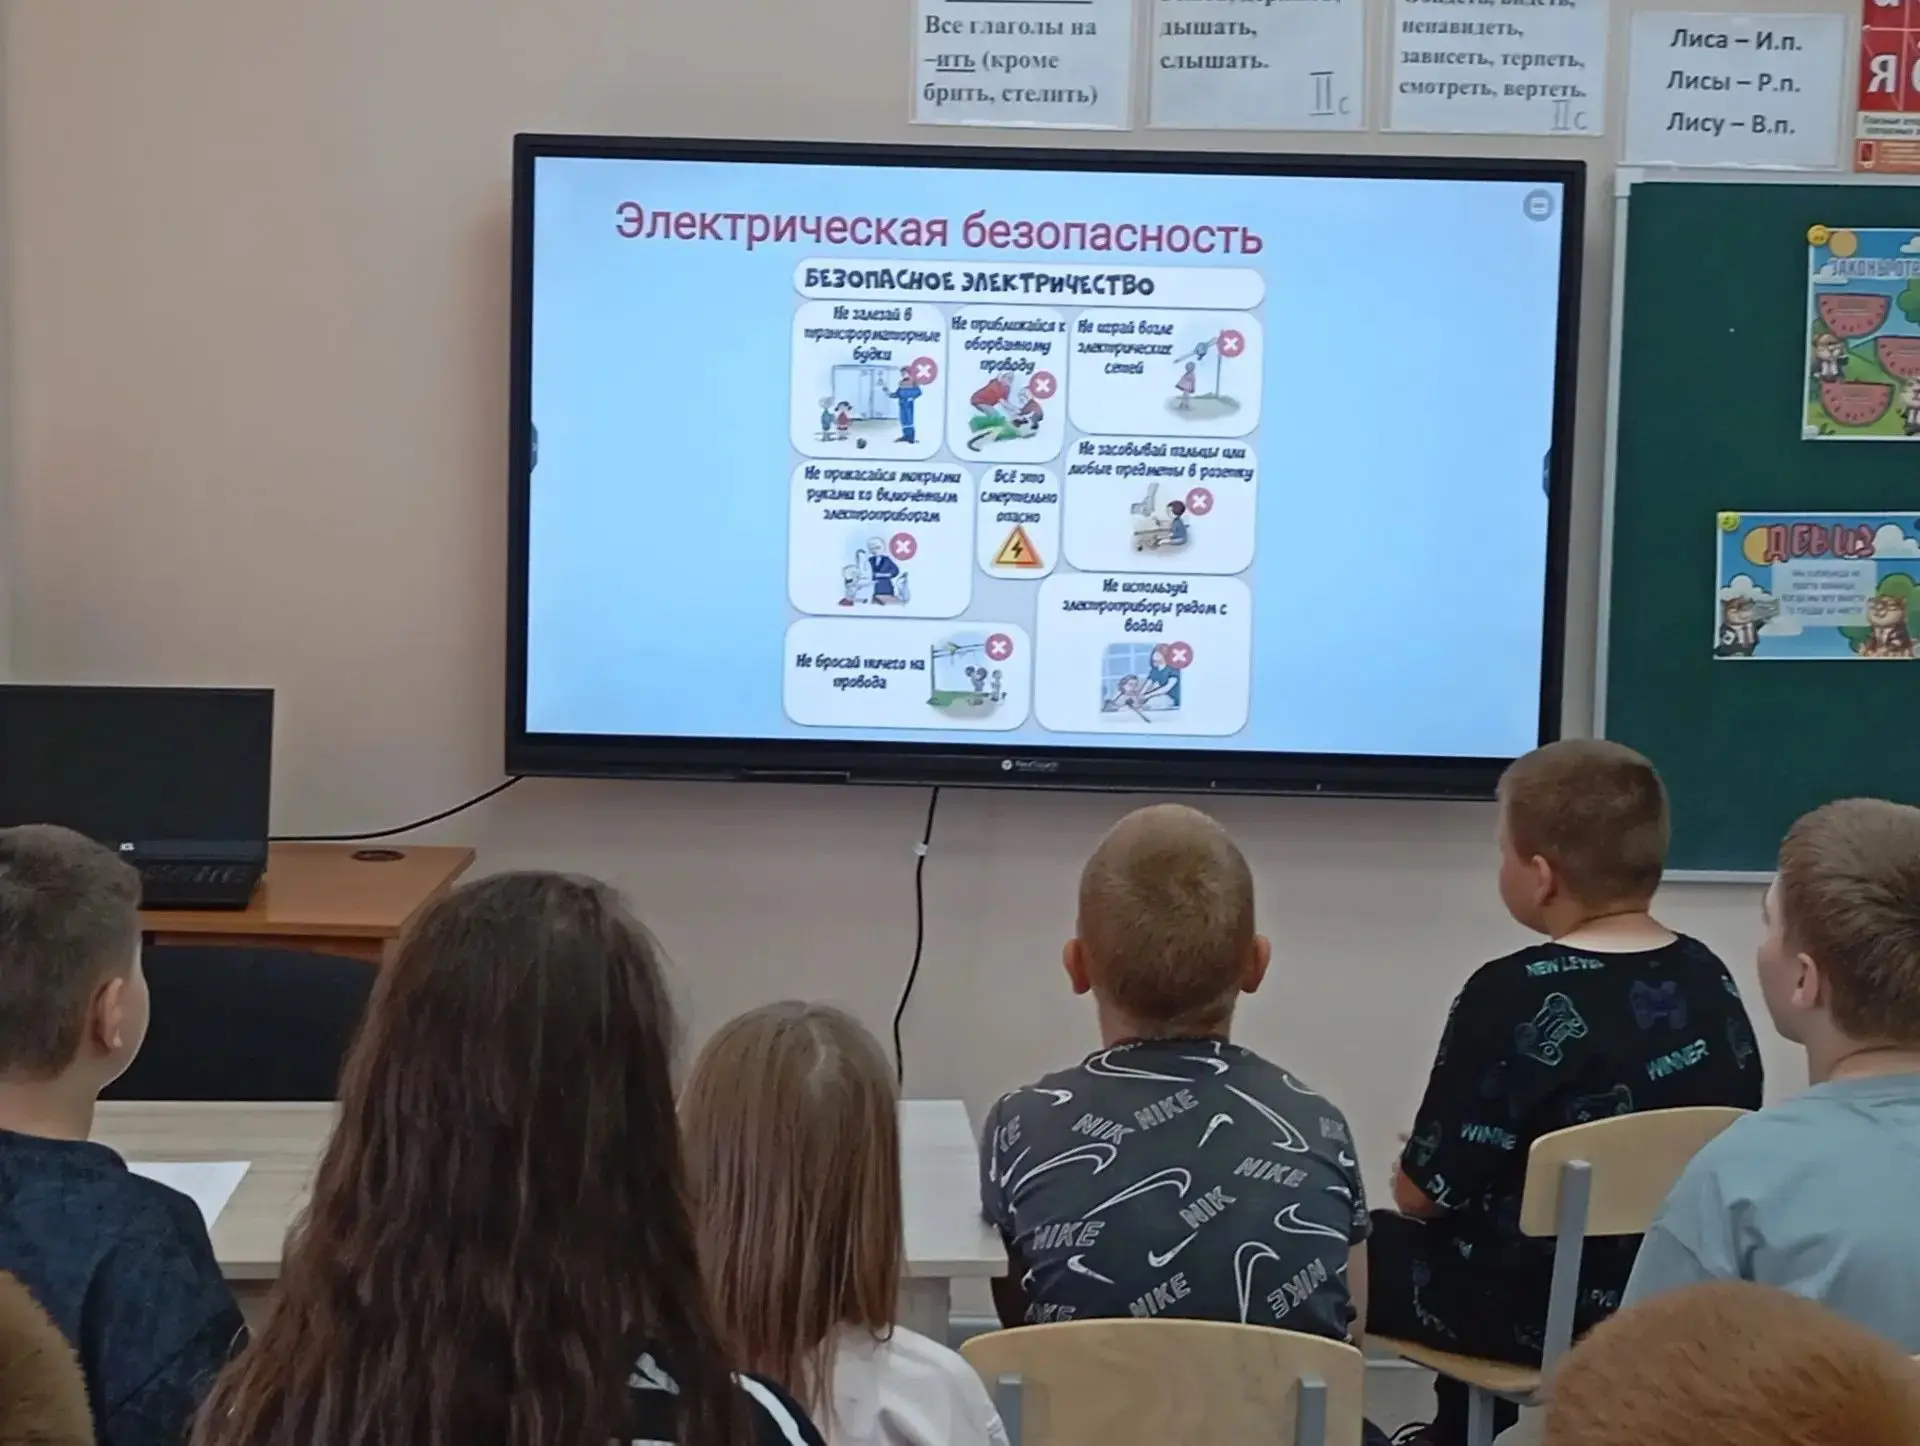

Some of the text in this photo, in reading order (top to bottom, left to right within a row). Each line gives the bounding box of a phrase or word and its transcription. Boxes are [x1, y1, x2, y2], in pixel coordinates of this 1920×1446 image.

[925, 15, 1097, 36] Все глаголы на
[1159, 21, 1258, 38] дышать,
[1402, 20, 1525, 38] ненавидеть,
[1670, 28, 1728, 49] Лиса
[1756, 31, 1802, 51] И.п.
[982, 51, 1060, 73] (кроме
[1160, 54, 1270, 70] слышать.
[1401, 51, 1585, 70] зависеть, терпеть,
[1399, 81, 1588, 101] смотреть, вертеть.
[1667, 70, 1731, 91] Лисы
[1758, 73, 1801, 93] Р.п.
[924, 83, 1099, 106] брить, стелить)
[1666, 112, 1725, 137] Лису
[1752, 115, 1796, 134] В.п.
[616, 201, 1264, 254] Электрическая безопасность
[805, 267, 1155, 296] БЕЗОПАСНОЕ ЭЛЕКТРИЧЕСТВО
[833, 305, 913, 321] Не залезай в
[951, 315, 1066, 333] Не приближайся к
[1077, 319, 1174, 336] Не играй возле
[804, 328, 942, 344] трансформаторные
[964, 336, 1052, 355] оборванному
[853, 345, 892, 364] будки
[979, 357, 1036, 375] проводу
[1104, 361, 1144, 374] сетей
[1078, 440, 1246, 459] Не засовывай пальцы или
[805, 465, 962, 486] Не прикасайся мокрыми
[1020, 473, 1045, 484] это
[1067, 461, 1254, 482] любые предметы в розетку
[806, 488, 856, 504] руками
[859, 490, 873, 501] ко
[980, 491, 1059, 507] смертельно
[823, 507, 941, 523] электроприборам
[996, 512, 1041, 523] опасно
[1103, 578, 1189, 597] Не используй
[1062, 598, 1229, 616] электроприборы рядом с
[1124, 617, 1164, 632] водой
[796, 653, 926, 671] Не бросай ничего на
[833, 674, 888, 691] провода
[1133, 1088, 1200, 1131] NIKE
[1234, 1156, 1309, 1188] NIKE
[1032, 1221, 1106, 1250] NIKE
[1128, 1271, 1192, 1318] NIKE
